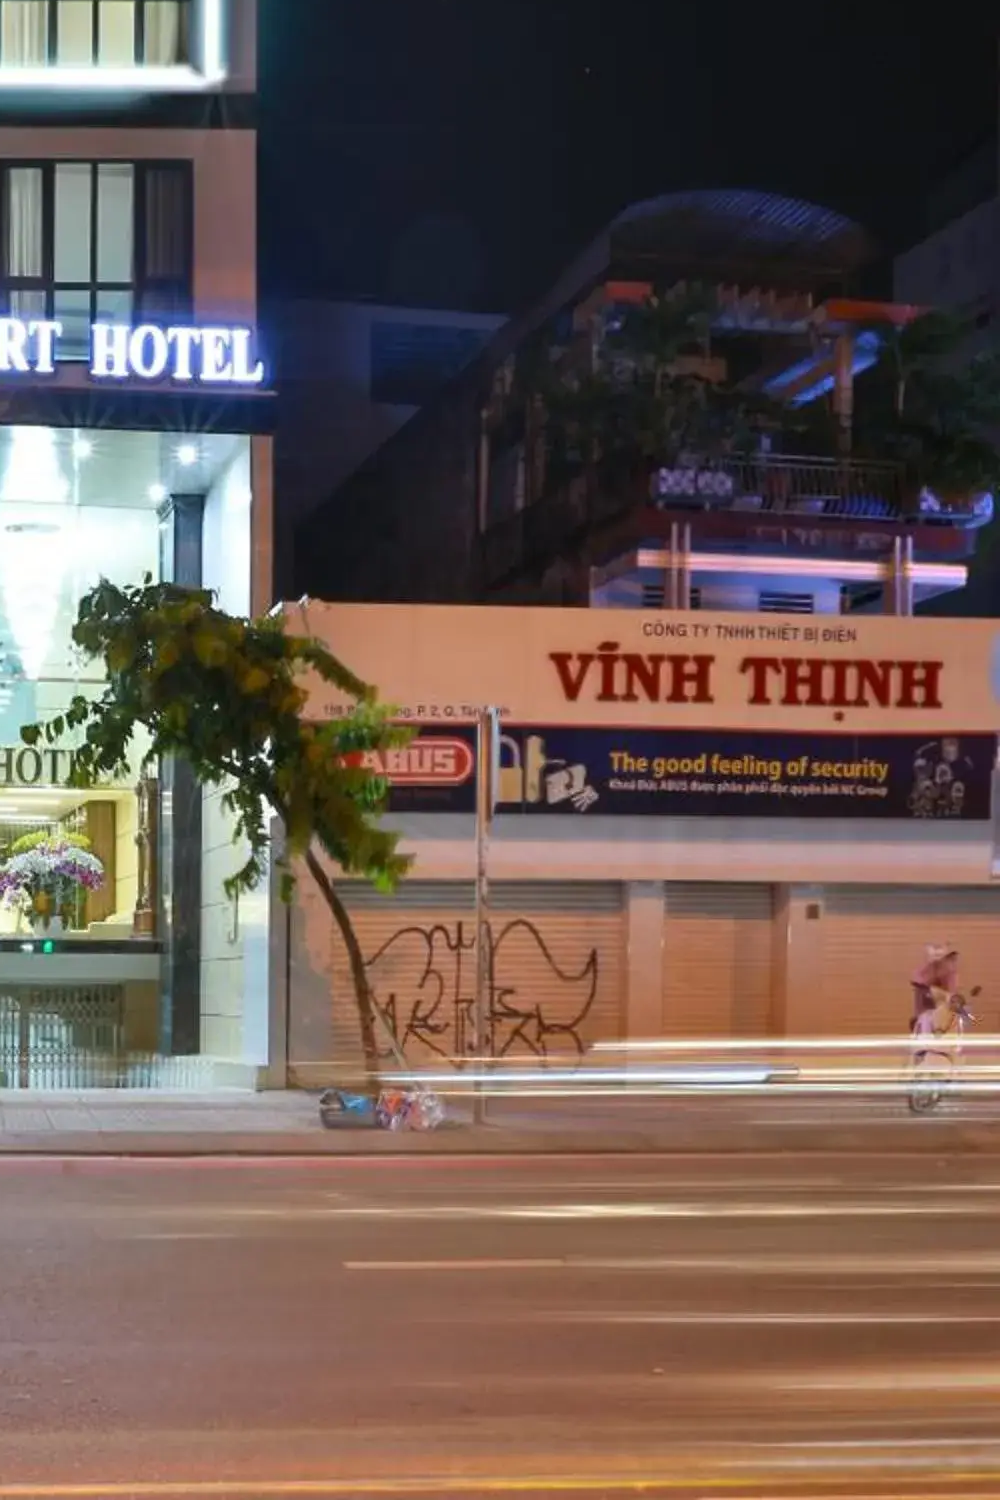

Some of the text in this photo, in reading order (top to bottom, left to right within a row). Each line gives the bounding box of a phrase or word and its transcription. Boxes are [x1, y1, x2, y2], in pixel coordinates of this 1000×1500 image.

[91, 325, 264, 381] HOTEL
[642, 621, 688, 638] CÔNG
[692, 624, 710, 638] TY
[715, 625, 755, 639] TNHH
[548, 641, 944, 722] VĨNH THỊNH
[360, 748, 456, 774] ABUS
[609, 751, 888, 782] The good feeling of security
